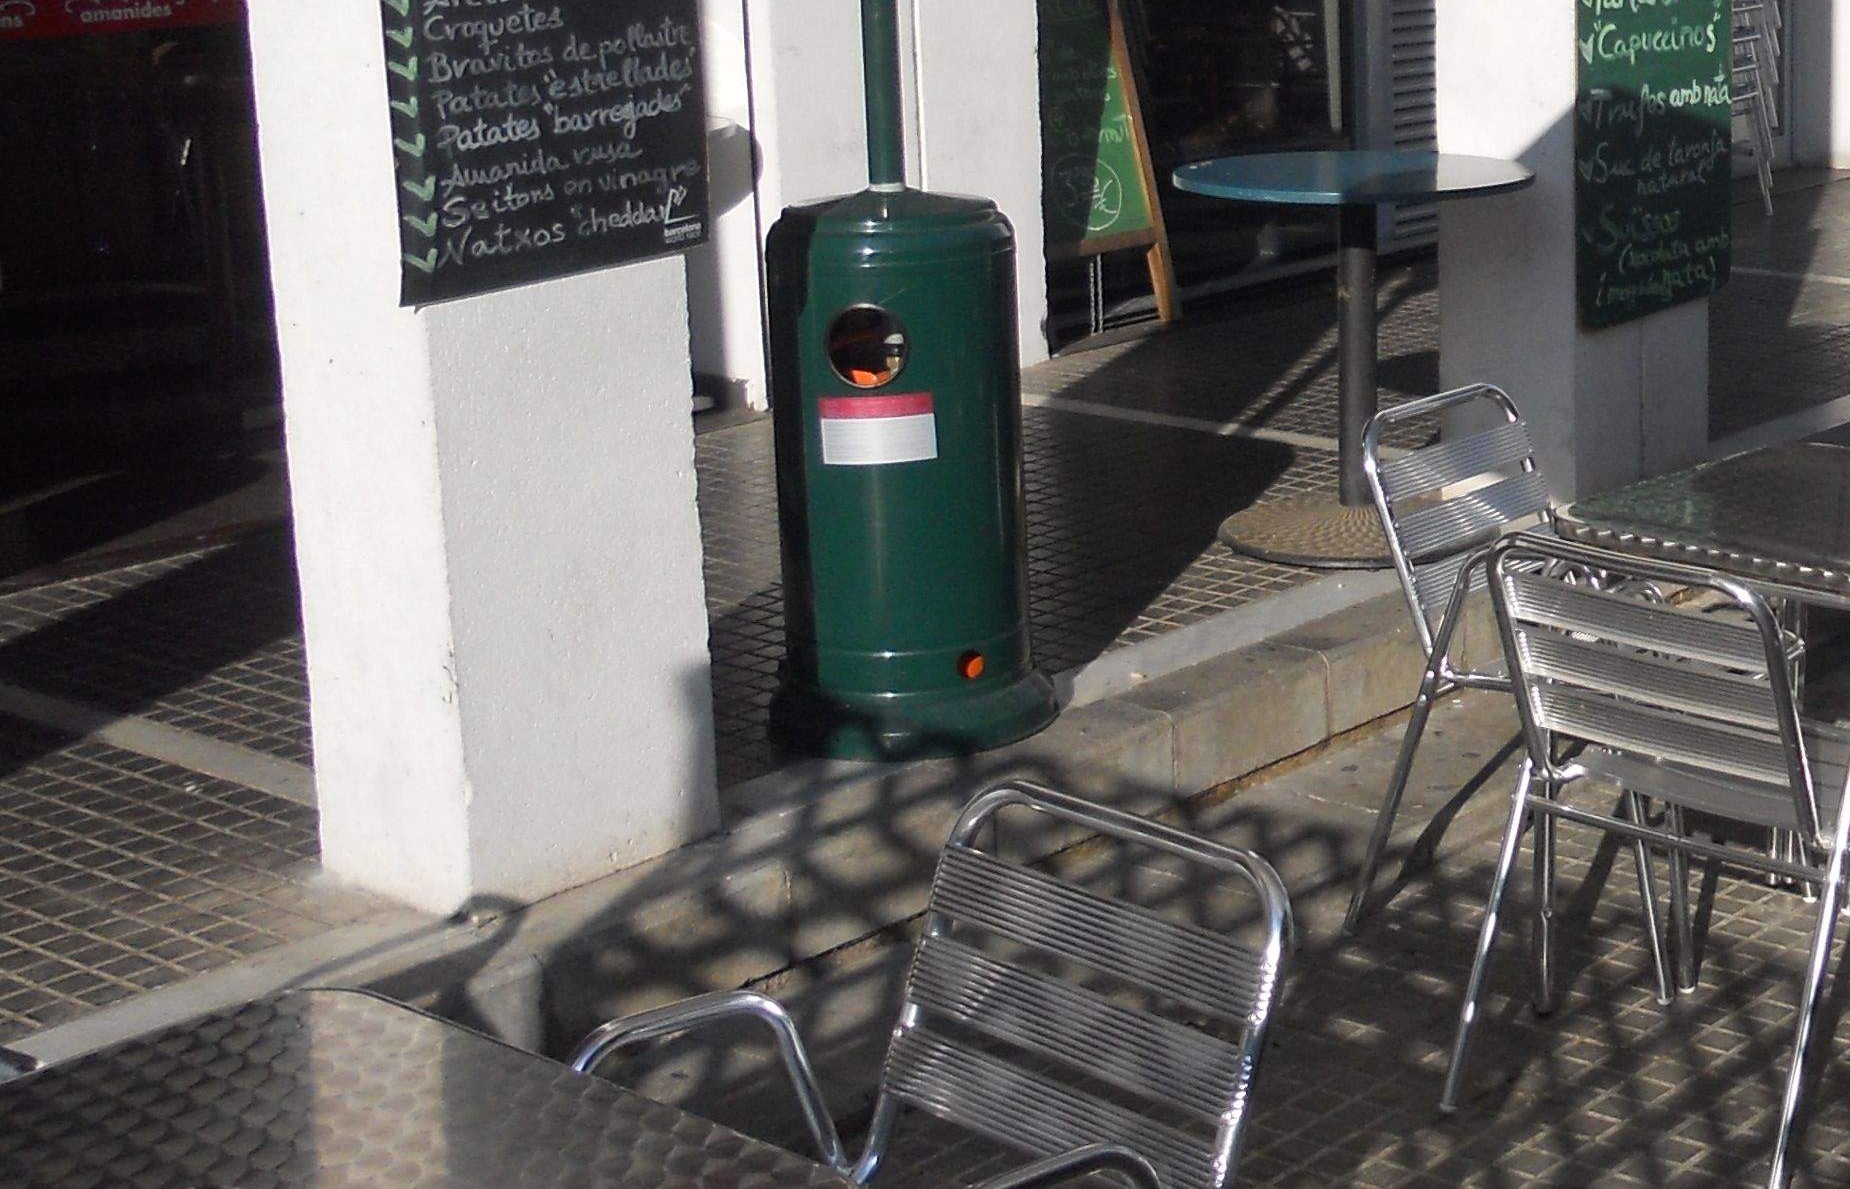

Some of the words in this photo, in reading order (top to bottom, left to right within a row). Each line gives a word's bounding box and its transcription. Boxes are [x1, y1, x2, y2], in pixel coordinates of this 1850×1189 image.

[80, 2, 173, 23] amanides
[423, 4, 564, 56] Croquetes
[563, 34, 597, 61] de
[432, 82, 541, 120] Patates
[1669, 78, 1700, 108] amb
[1704, 64, 1733, 107] nata
[437, 112, 542, 153] Patates
[1640, 144, 1662, 172] de
[442, 183, 554, 227] Seitons
[563, 178, 593, 196] en
[599, 163, 700, 195] vinagre
[438, 221, 566, 268] Natxos
